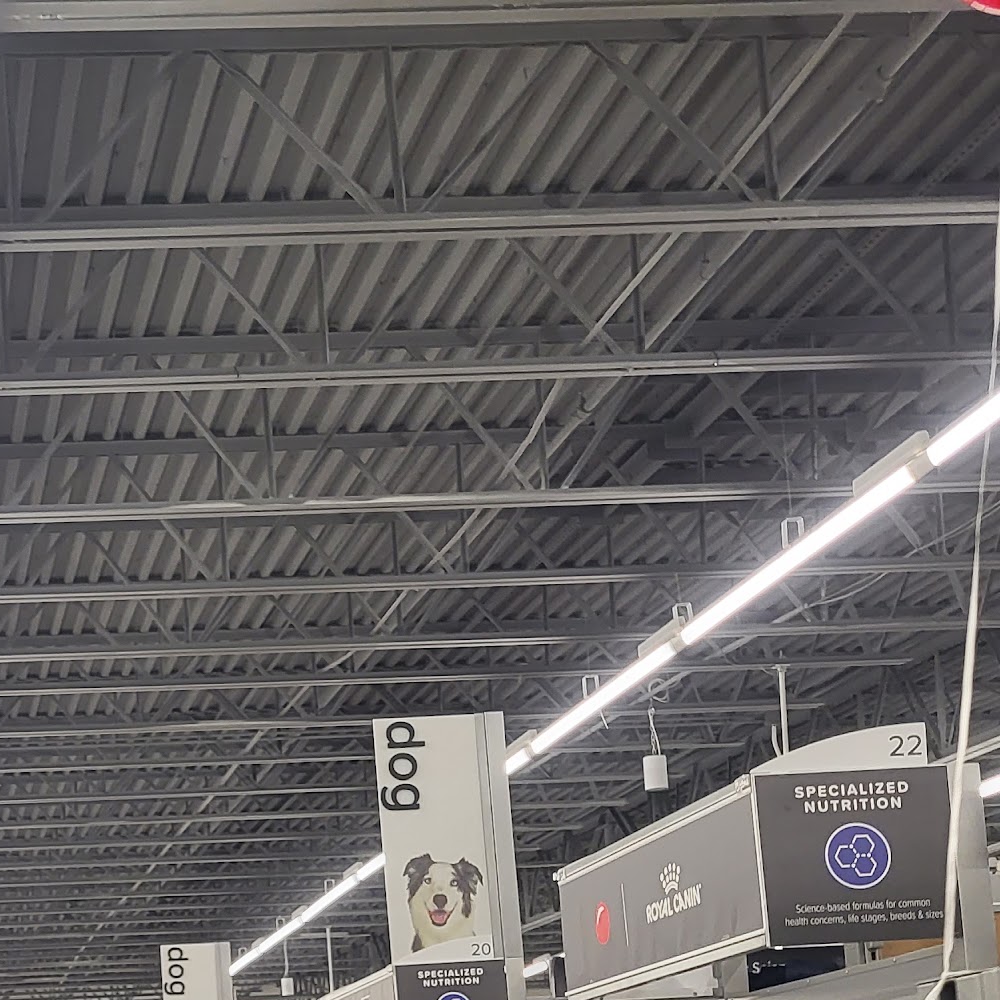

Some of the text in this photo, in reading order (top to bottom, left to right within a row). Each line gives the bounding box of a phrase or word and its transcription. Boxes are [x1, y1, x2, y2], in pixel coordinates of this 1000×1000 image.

[889, 735, 923, 757] 22
[381, 721, 425, 811] dog
[794, 780, 909, 799] SPECIALIZED
[803, 796, 903, 814] NUTRITION
[645, 884, 701, 925] ROYAL CANIN
[795, 898, 931, 914] Science-based formulas for common
[784, 909, 944, 927] health concerns, life stages, breeds & sizes
[471, 943, 491, 956] 20
[164, 946, 189, 996] dog
[417, 967, 484, 979] SPECIALIZED
[423, 976, 480, 988] NUTRITION
